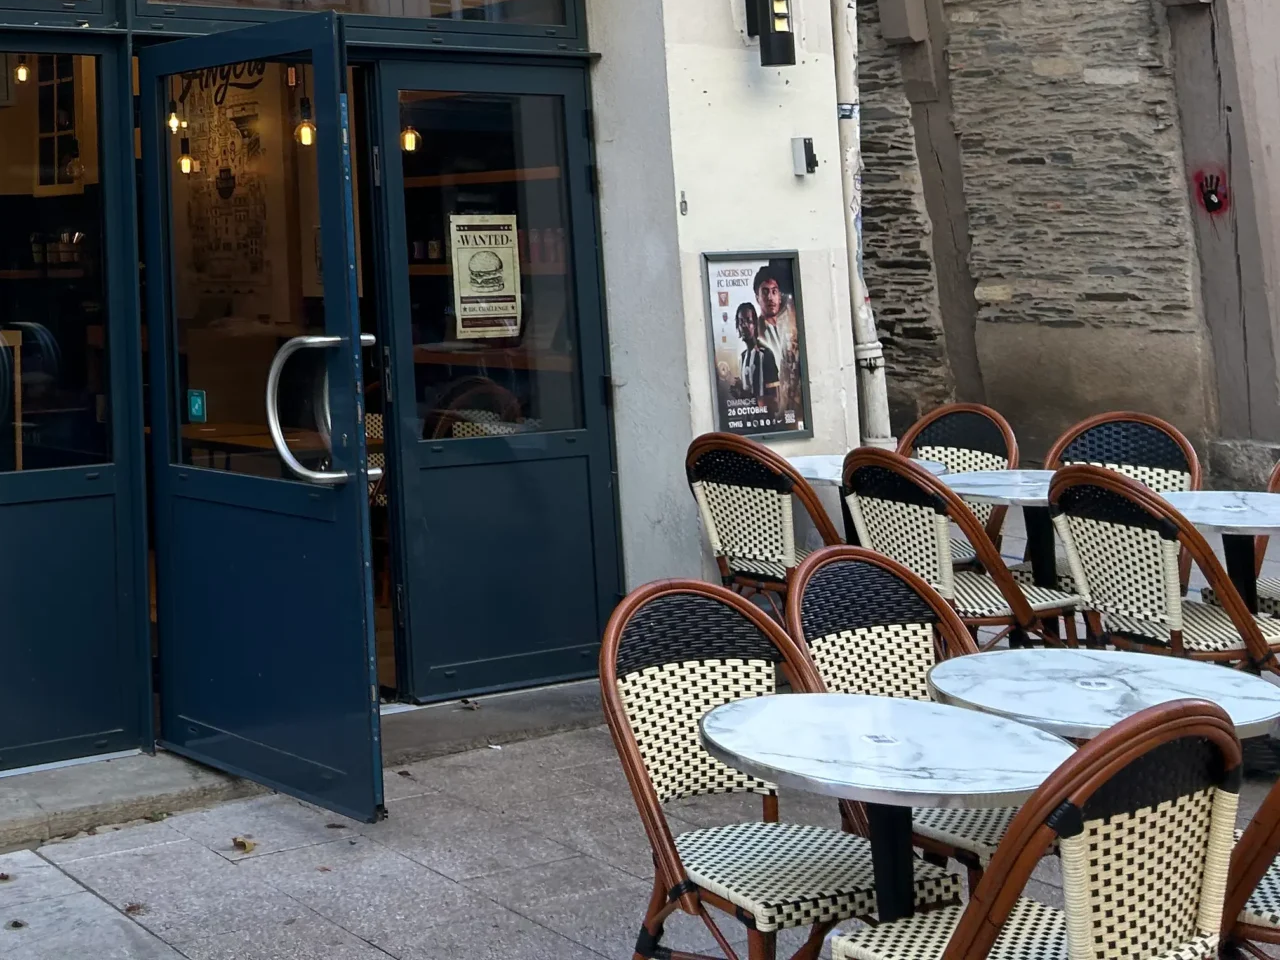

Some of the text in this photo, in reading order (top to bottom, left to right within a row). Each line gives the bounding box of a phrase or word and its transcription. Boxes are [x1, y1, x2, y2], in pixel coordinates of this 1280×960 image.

[460, 234, 509, 246] WANTED
[716, 269, 740, 278] ANGERS
[726, 397, 757, 407] DIMANCHE
[727, 405, 769, 417] 26 OCTOBRE
